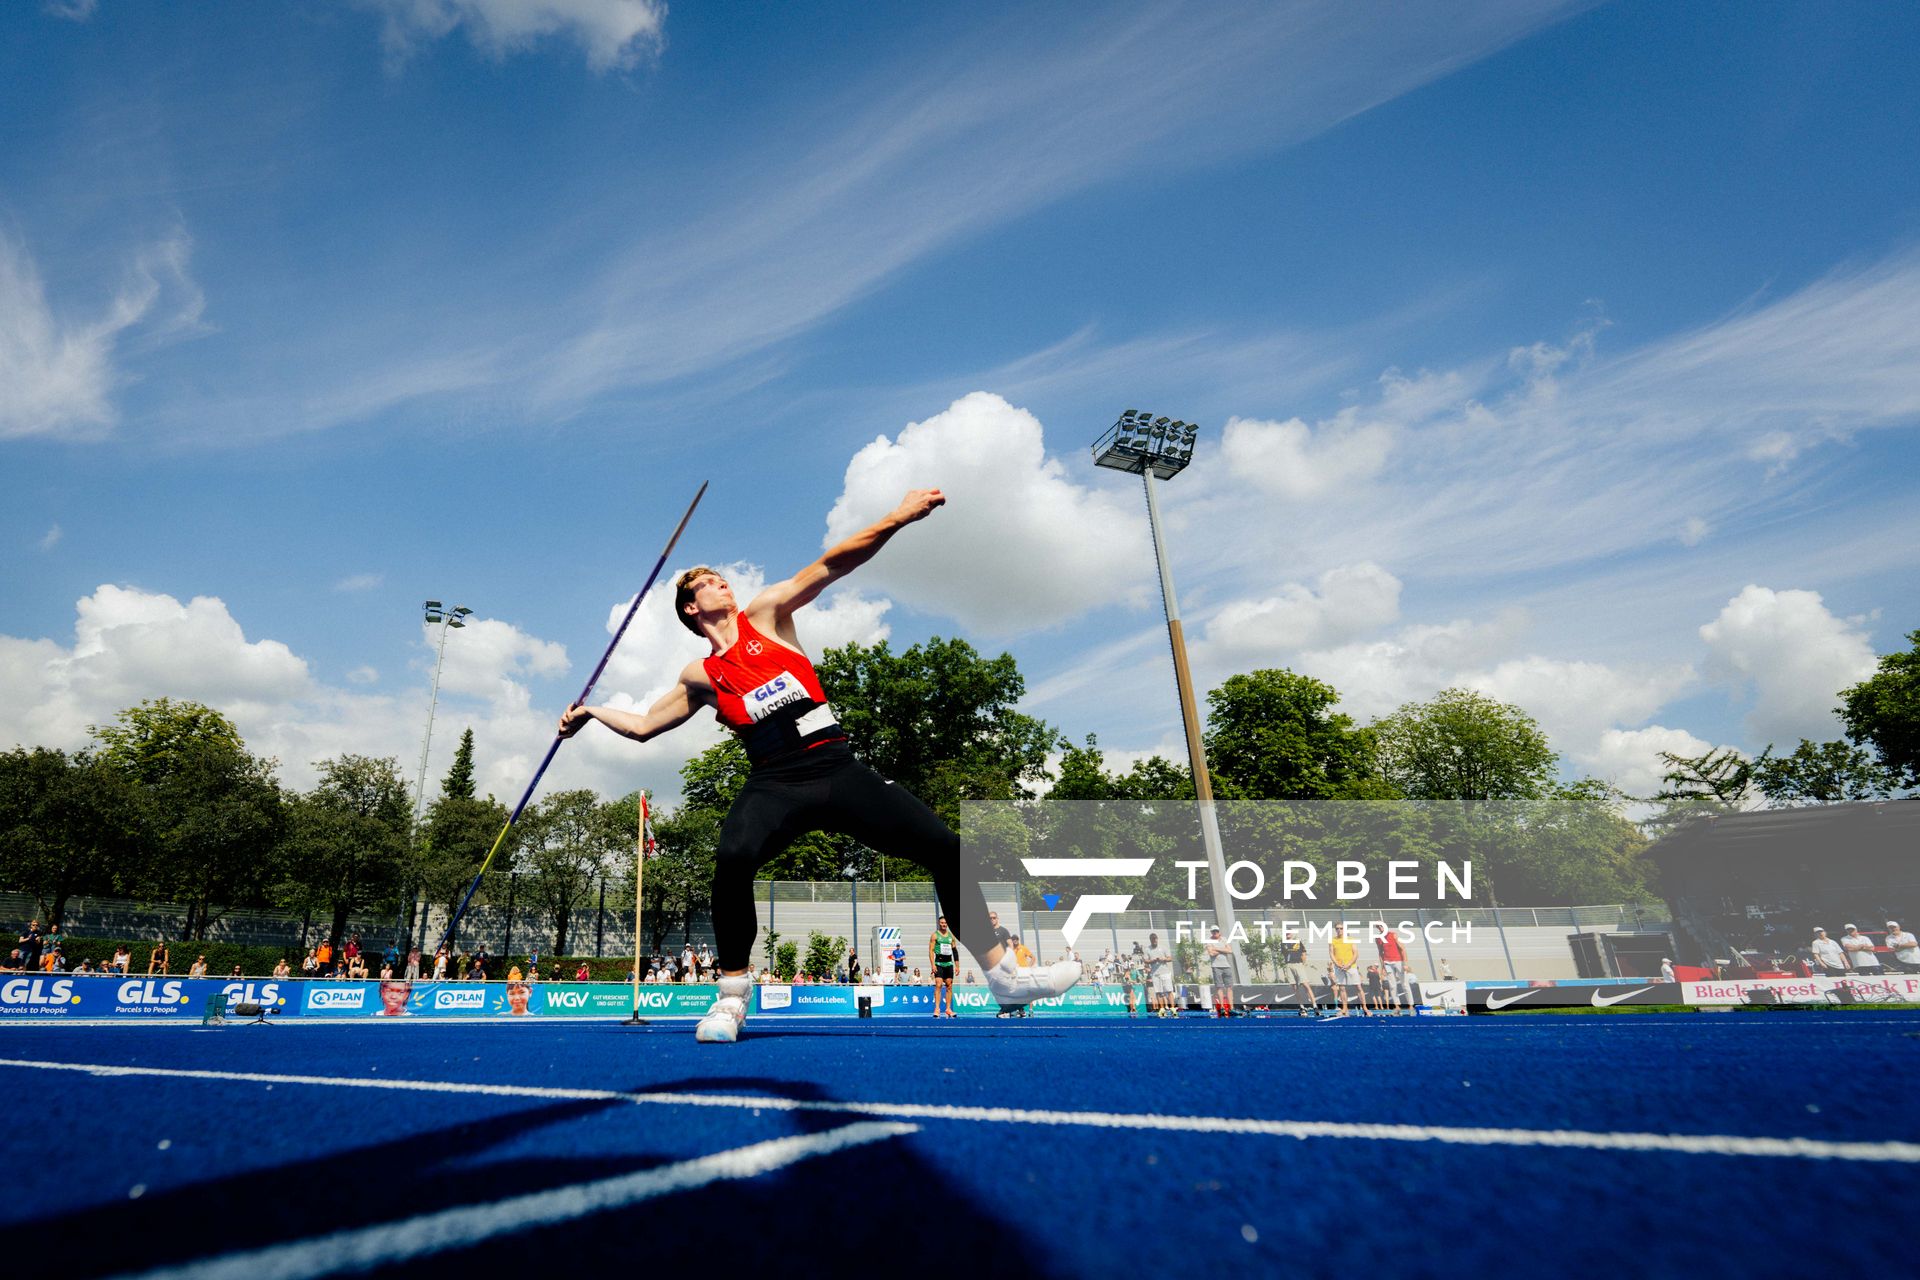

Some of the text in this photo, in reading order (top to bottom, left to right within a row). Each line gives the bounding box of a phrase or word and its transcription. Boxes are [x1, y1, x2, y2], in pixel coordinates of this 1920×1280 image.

[1695, 984, 1748, 998] Black
[332, 992, 362, 1001] PLAN
[456, 993, 483, 1001] PLAN
[547, 991, 590, 1008] WGV
[798, 996, 847, 1004] Echt.Gut.Leben.
[953, 992, 990, 1007] WGV
[40, 1007, 68, 1015] People
[153, 1006, 178, 1014] People
